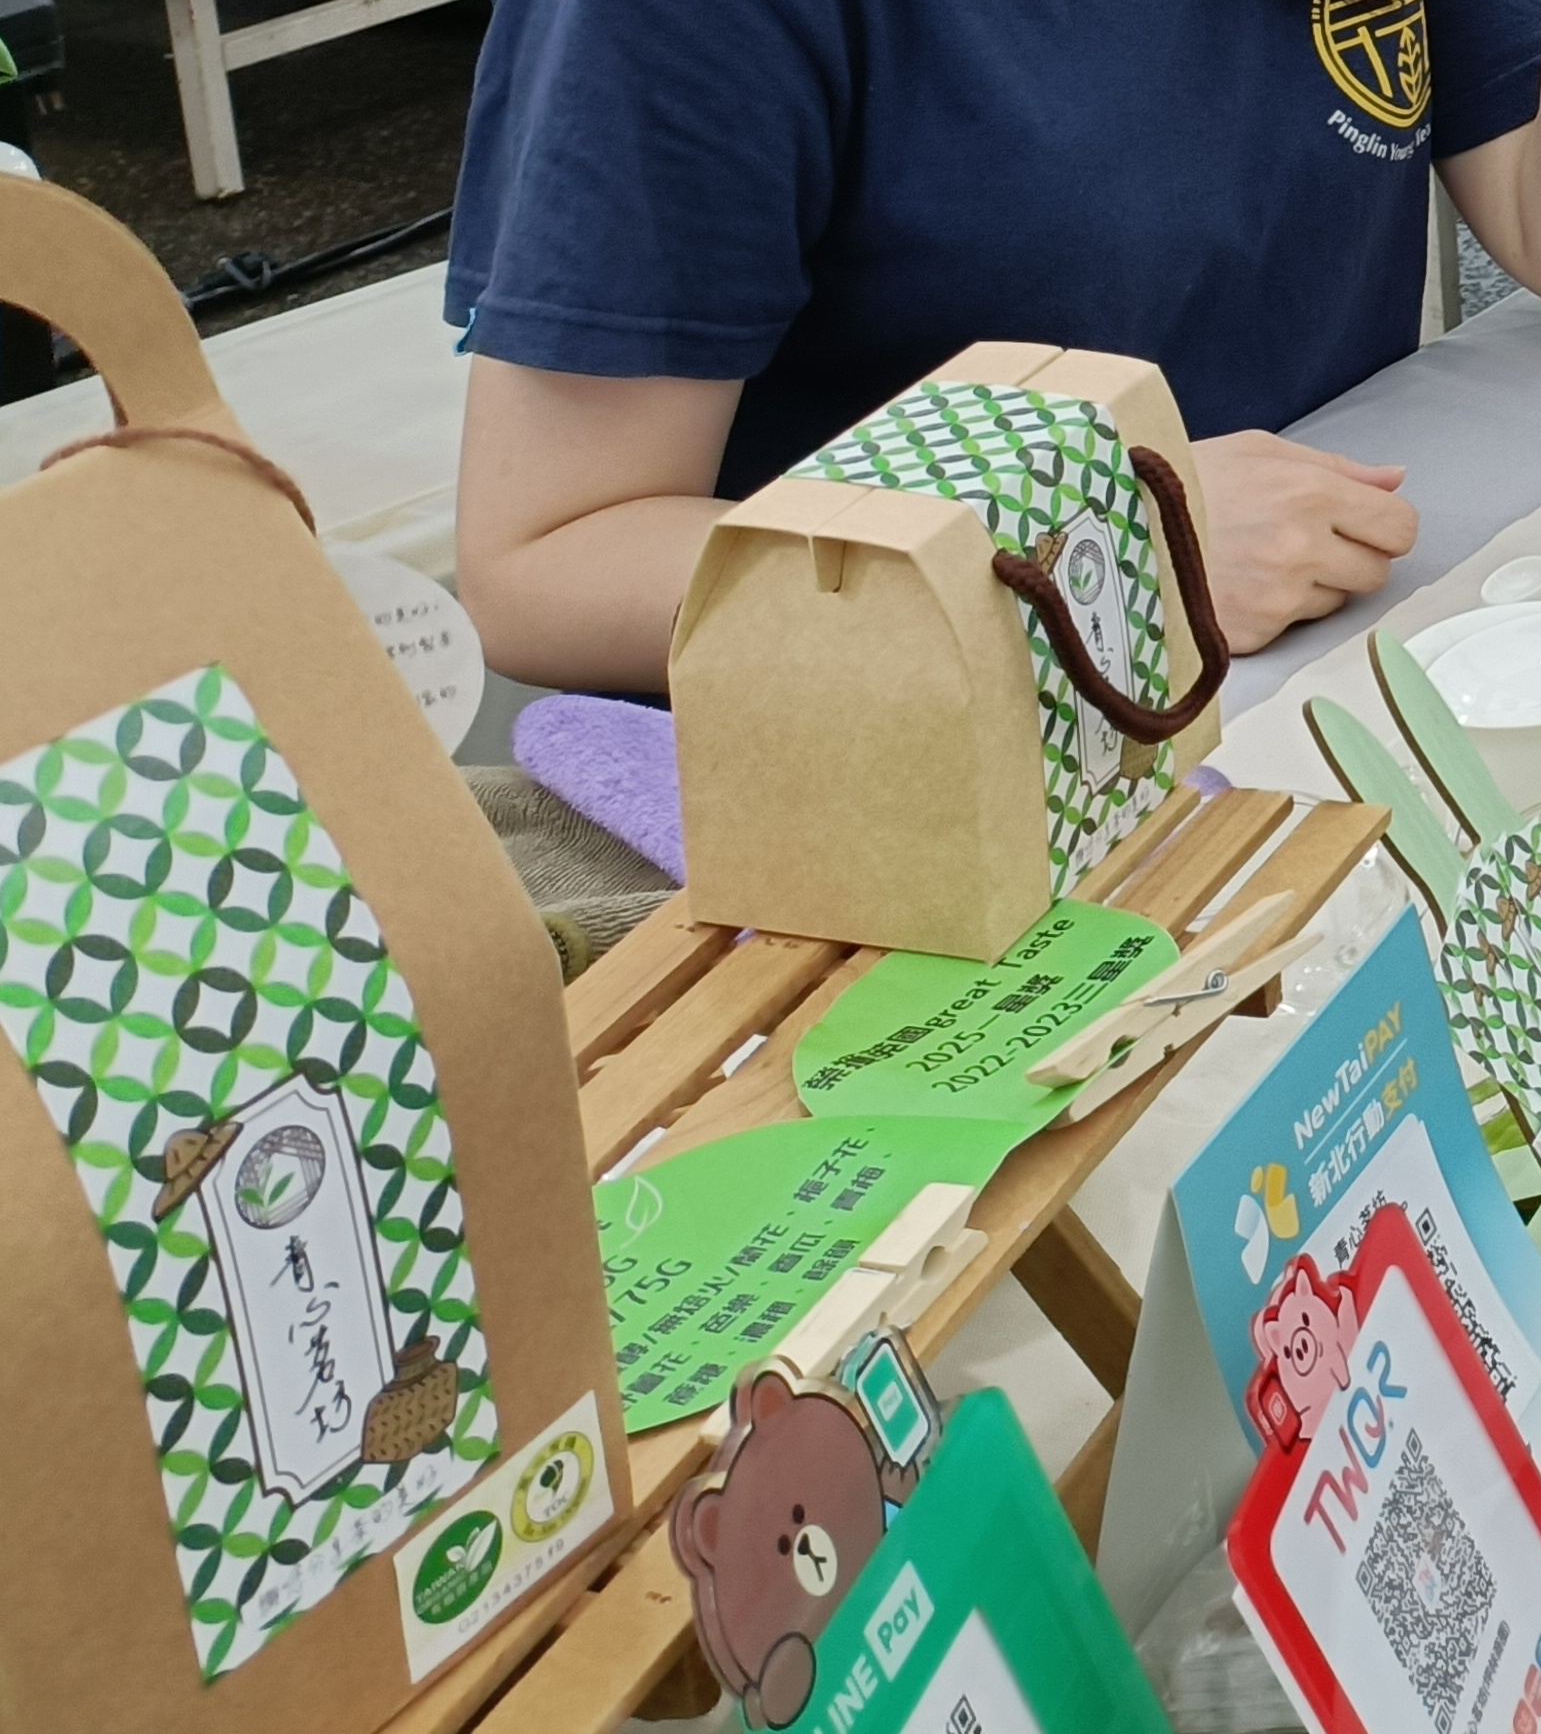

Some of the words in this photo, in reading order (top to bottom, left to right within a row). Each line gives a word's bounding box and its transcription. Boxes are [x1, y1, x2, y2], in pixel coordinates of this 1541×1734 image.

[1326, 108, 1389, 159] Pinglin
[1086, 612, 1119, 757] 青心坊
[991, 918, 1076, 970] Taste
[904, 972, 1065, 1073] 2025一星獎
[931, 935, 1156, 1094] 2022-2023三星獎
[1293, 1000, 1402, 1151] NewTaiPAY
[1308, 1057, 1421, 1208] 新北行動支付
[876, 1582, 924, 1656] Pay
